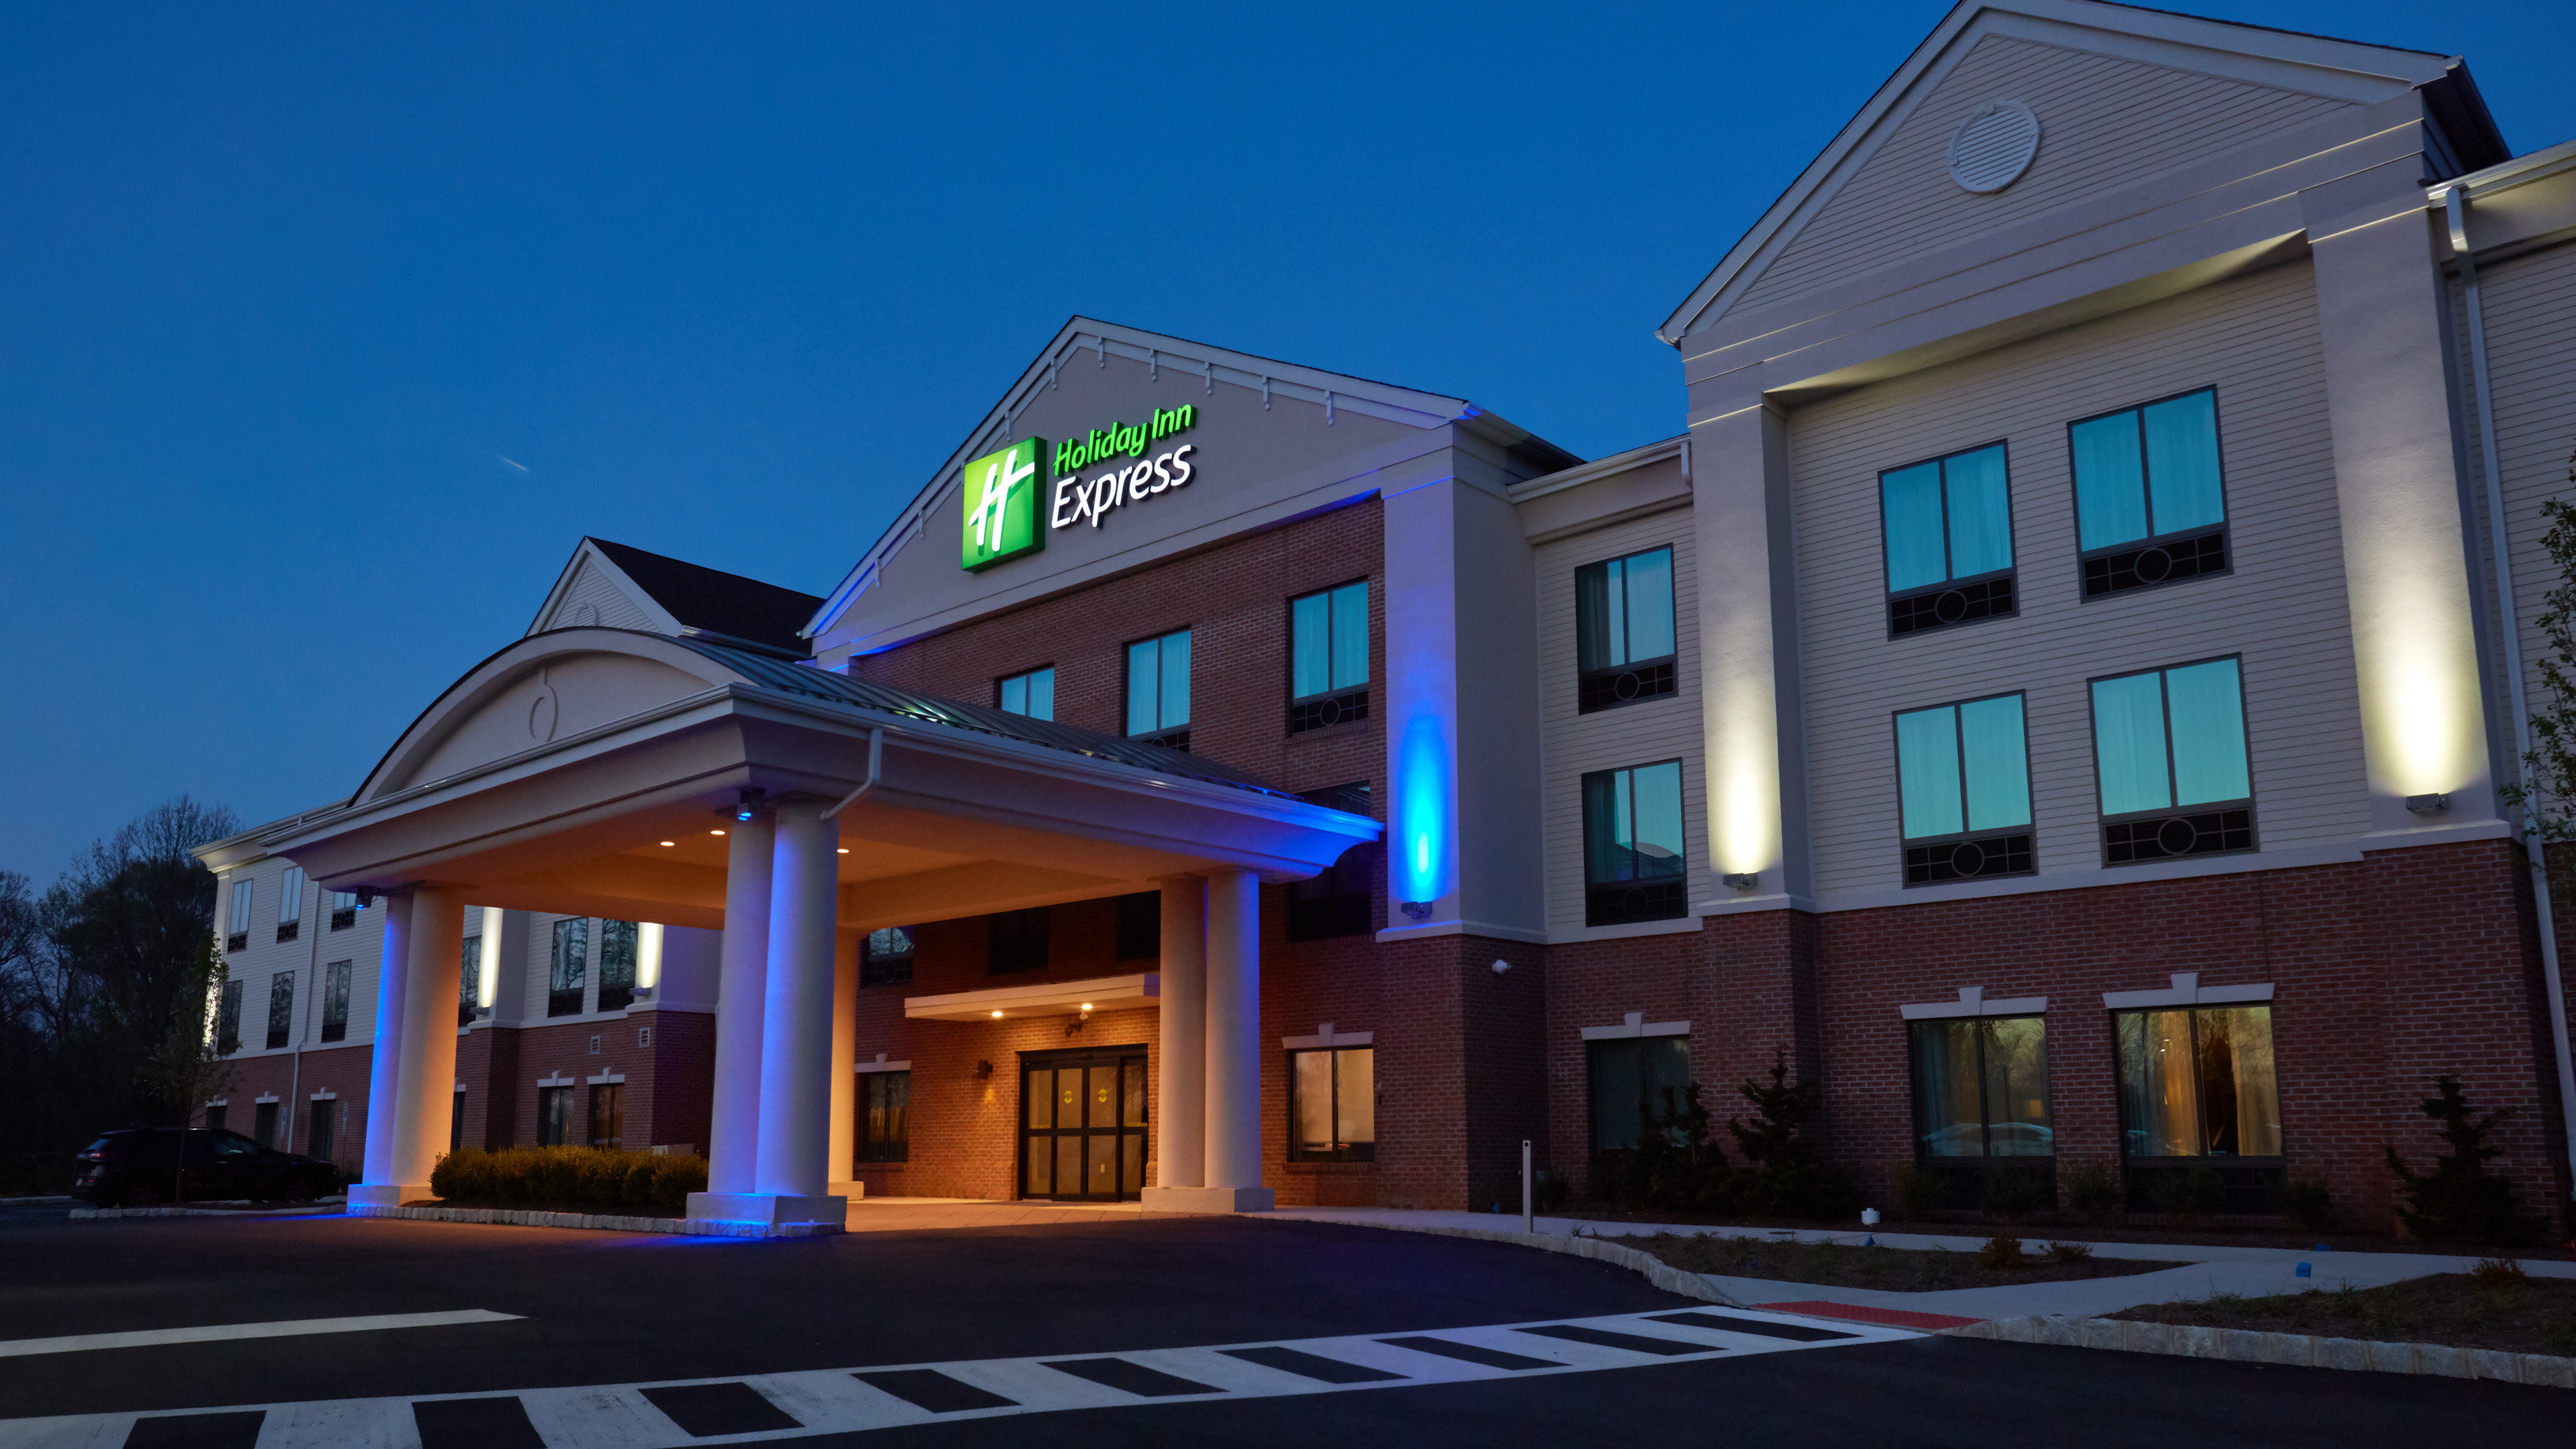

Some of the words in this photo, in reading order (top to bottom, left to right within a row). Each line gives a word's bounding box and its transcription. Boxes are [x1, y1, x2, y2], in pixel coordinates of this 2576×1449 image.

[1053, 421, 1148, 476] Holiday
[1151, 403, 1192, 439] Inn
[1051, 444, 1191, 529] Express
